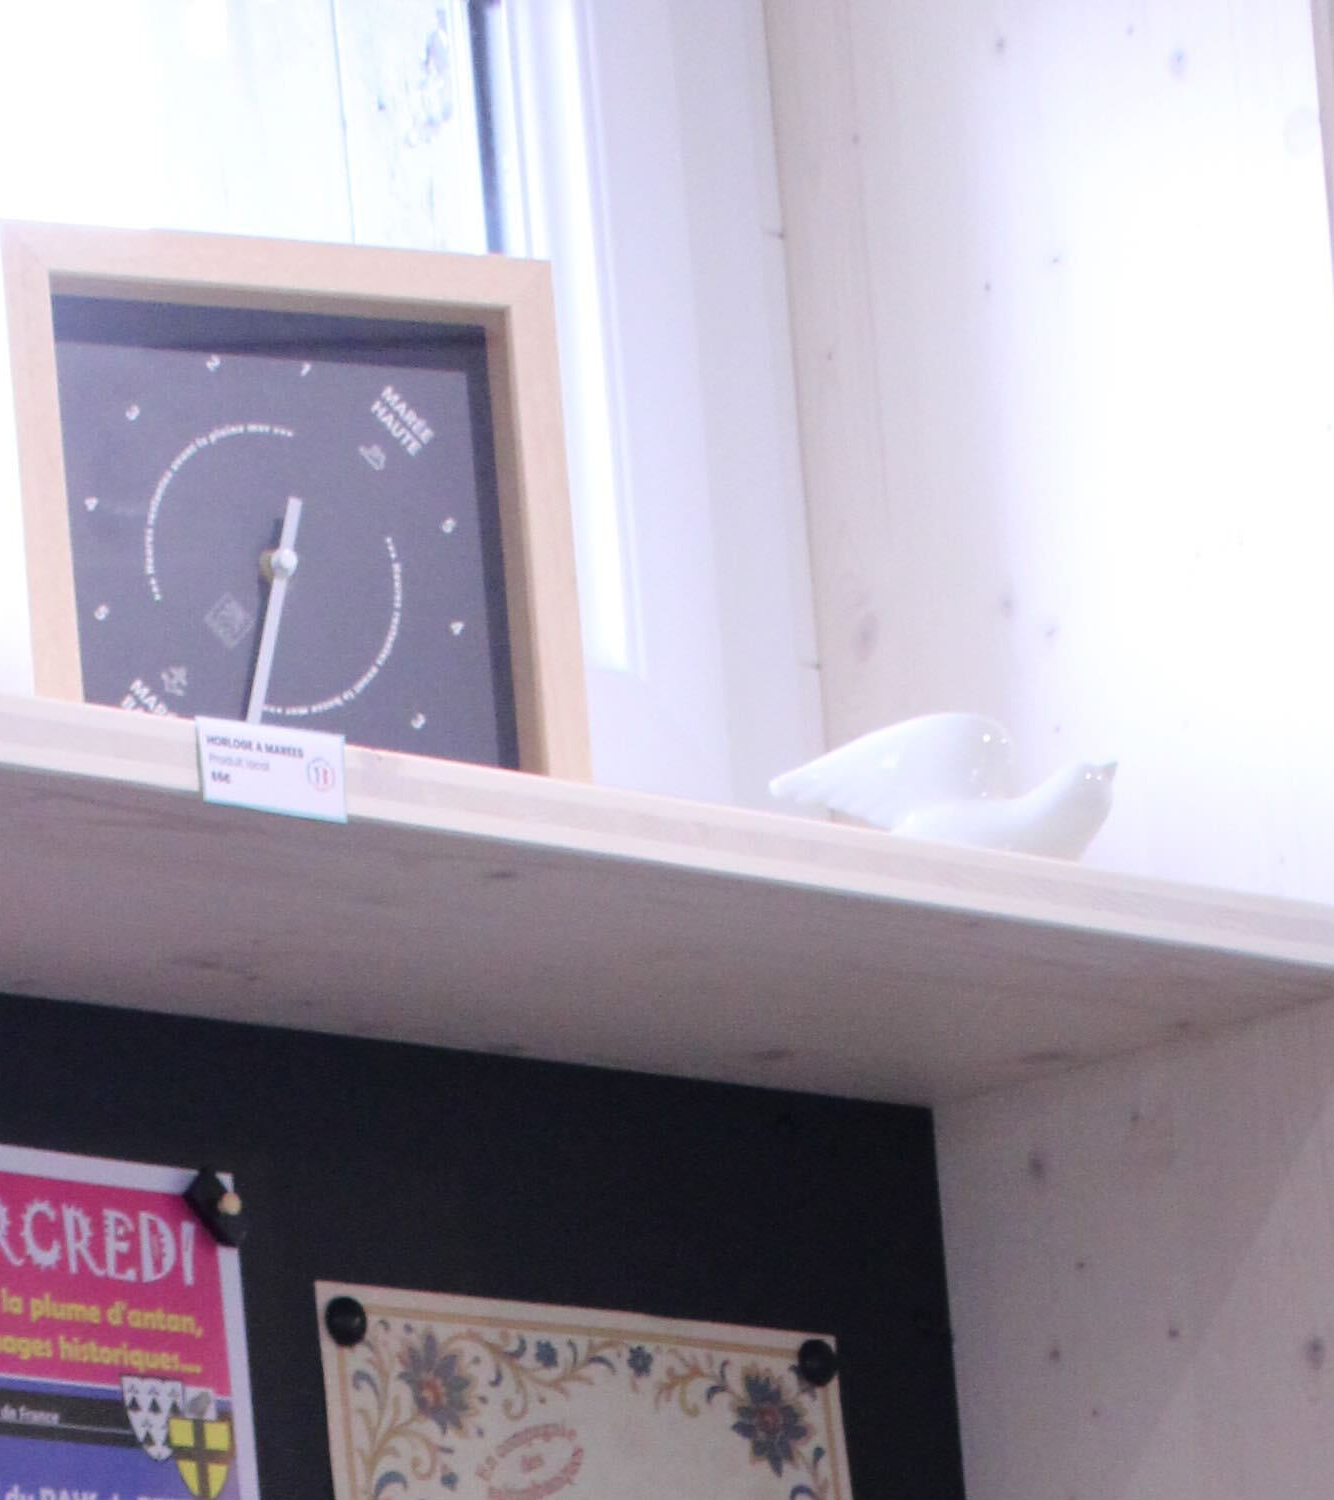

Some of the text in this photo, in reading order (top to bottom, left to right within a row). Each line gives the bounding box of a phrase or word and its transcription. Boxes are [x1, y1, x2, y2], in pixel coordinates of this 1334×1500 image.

[371, 401, 423, 456] HAUTE
[381, 385, 435, 444] MARÉE
[3, 1288, 23, 1314] la
[31, 1296, 100, 1324] plume
[108, 1301, 203, 1338] d'antan,
